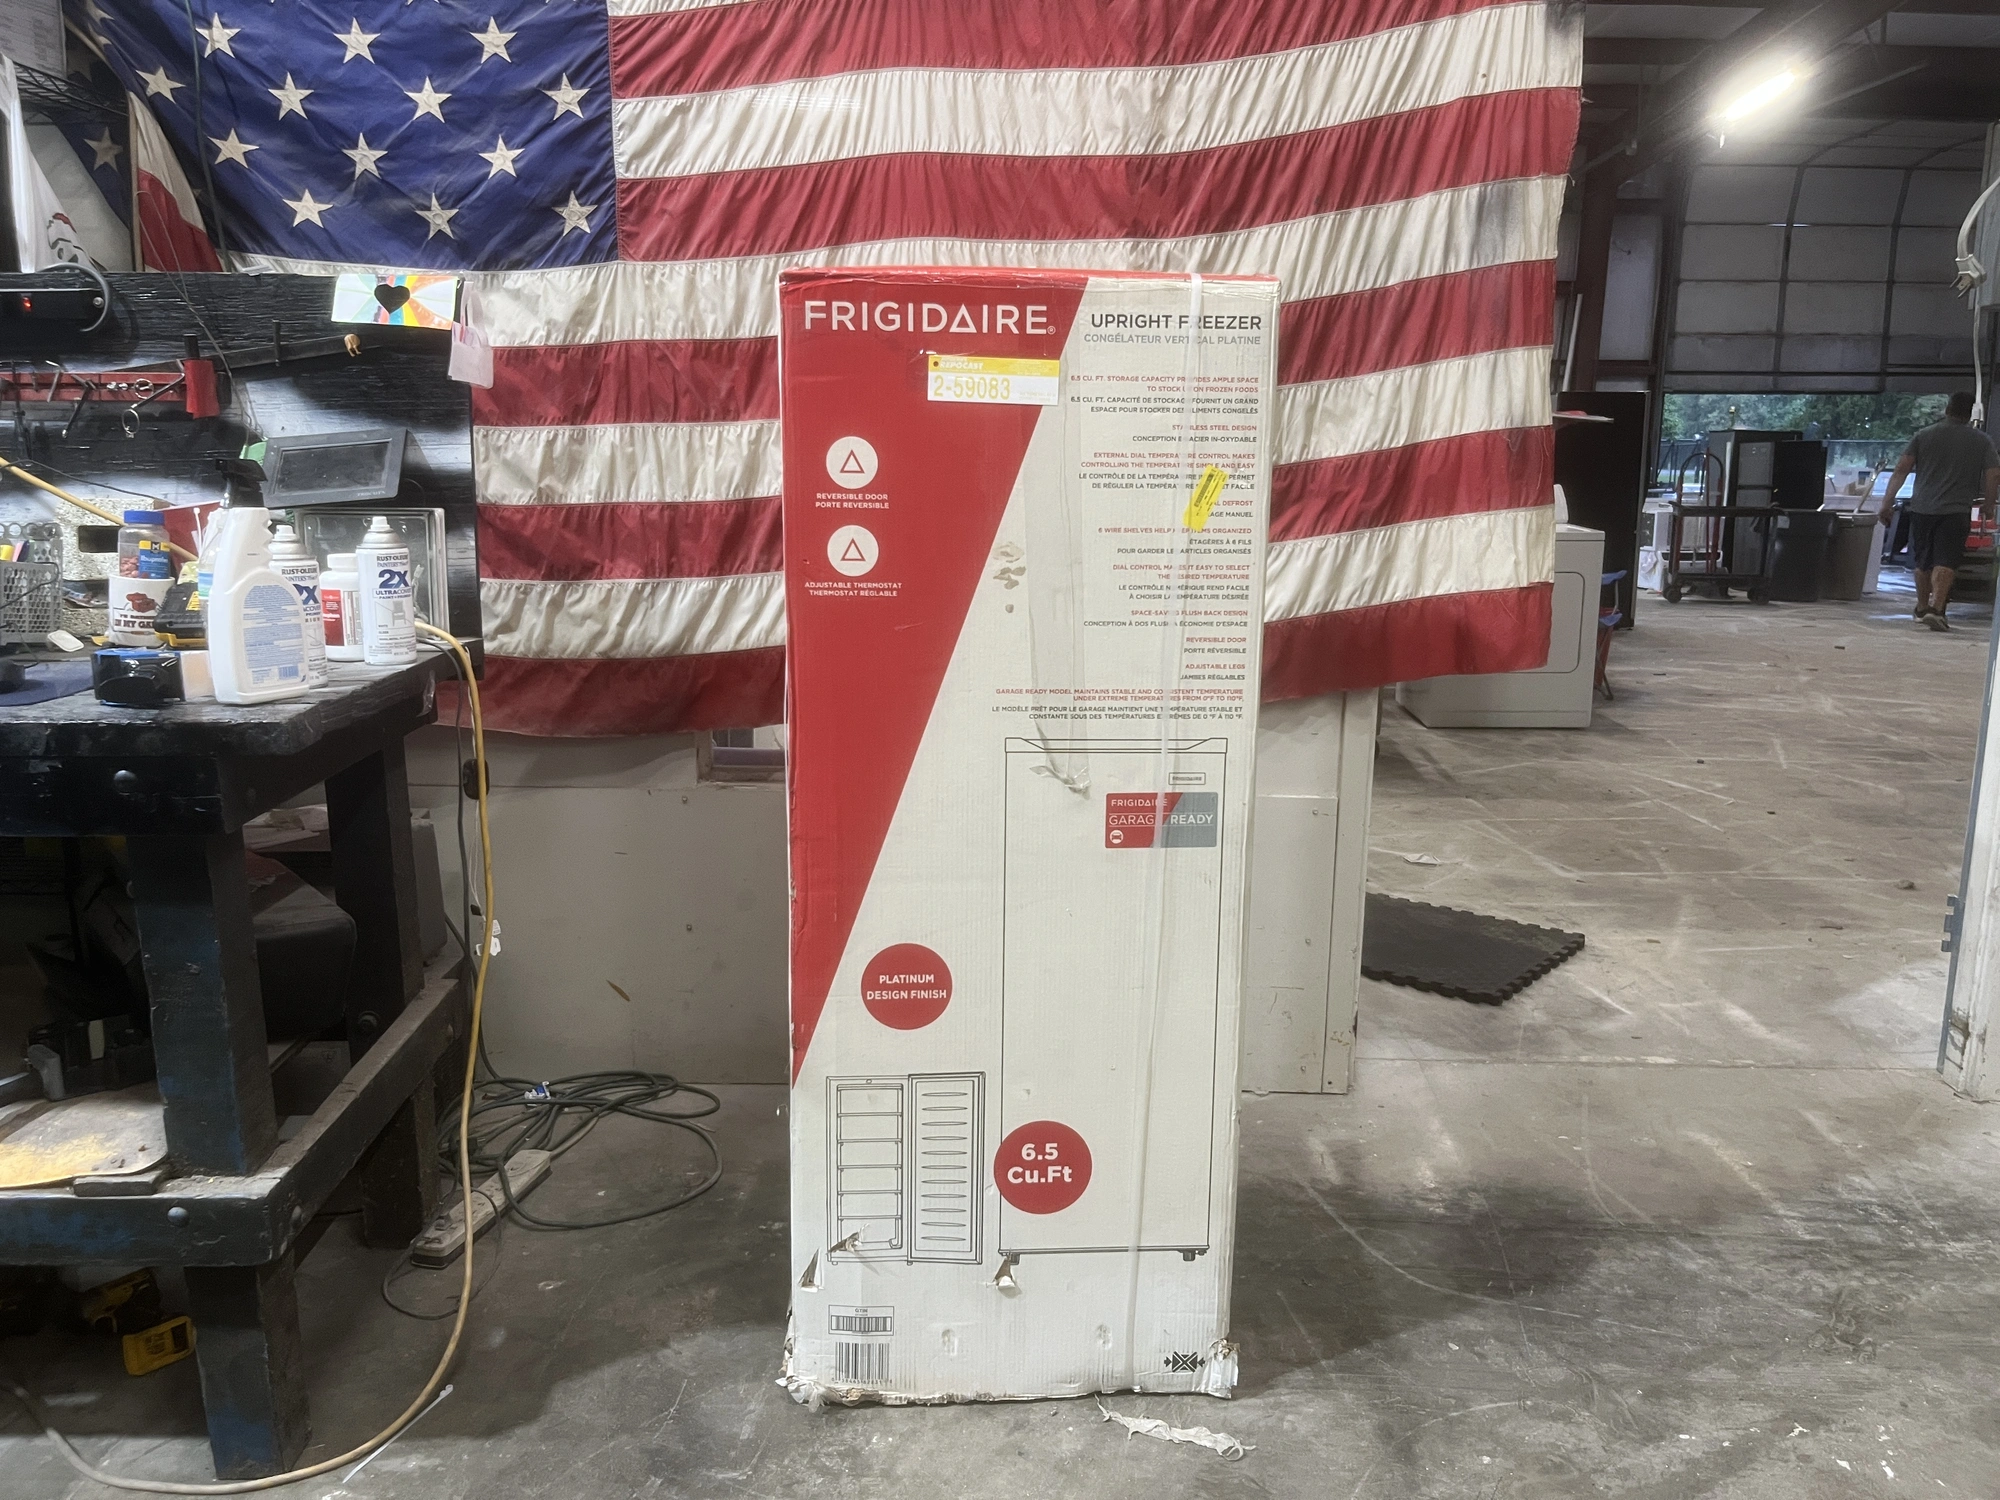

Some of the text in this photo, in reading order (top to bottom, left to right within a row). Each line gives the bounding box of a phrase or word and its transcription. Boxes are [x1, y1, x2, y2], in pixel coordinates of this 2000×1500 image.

[1092, 314, 1262, 330] UPRIGHT FEEZER
[1084, 333, 1261, 345] CONGÉLATEUR VERTCAL PLATINE
[934, 374, 1010, 399] 2-59083
[378, 569, 410, 589] 2X
[1109, 814, 1213, 825] GARAG READY
[879, 974, 934, 984] PLATINUM
[867, 990, 947, 1000] DESIGN FINISH
[1021, 1142, 1058, 1161] 6.5
[1007, 1166, 1072, 1184] Cu.Ft
